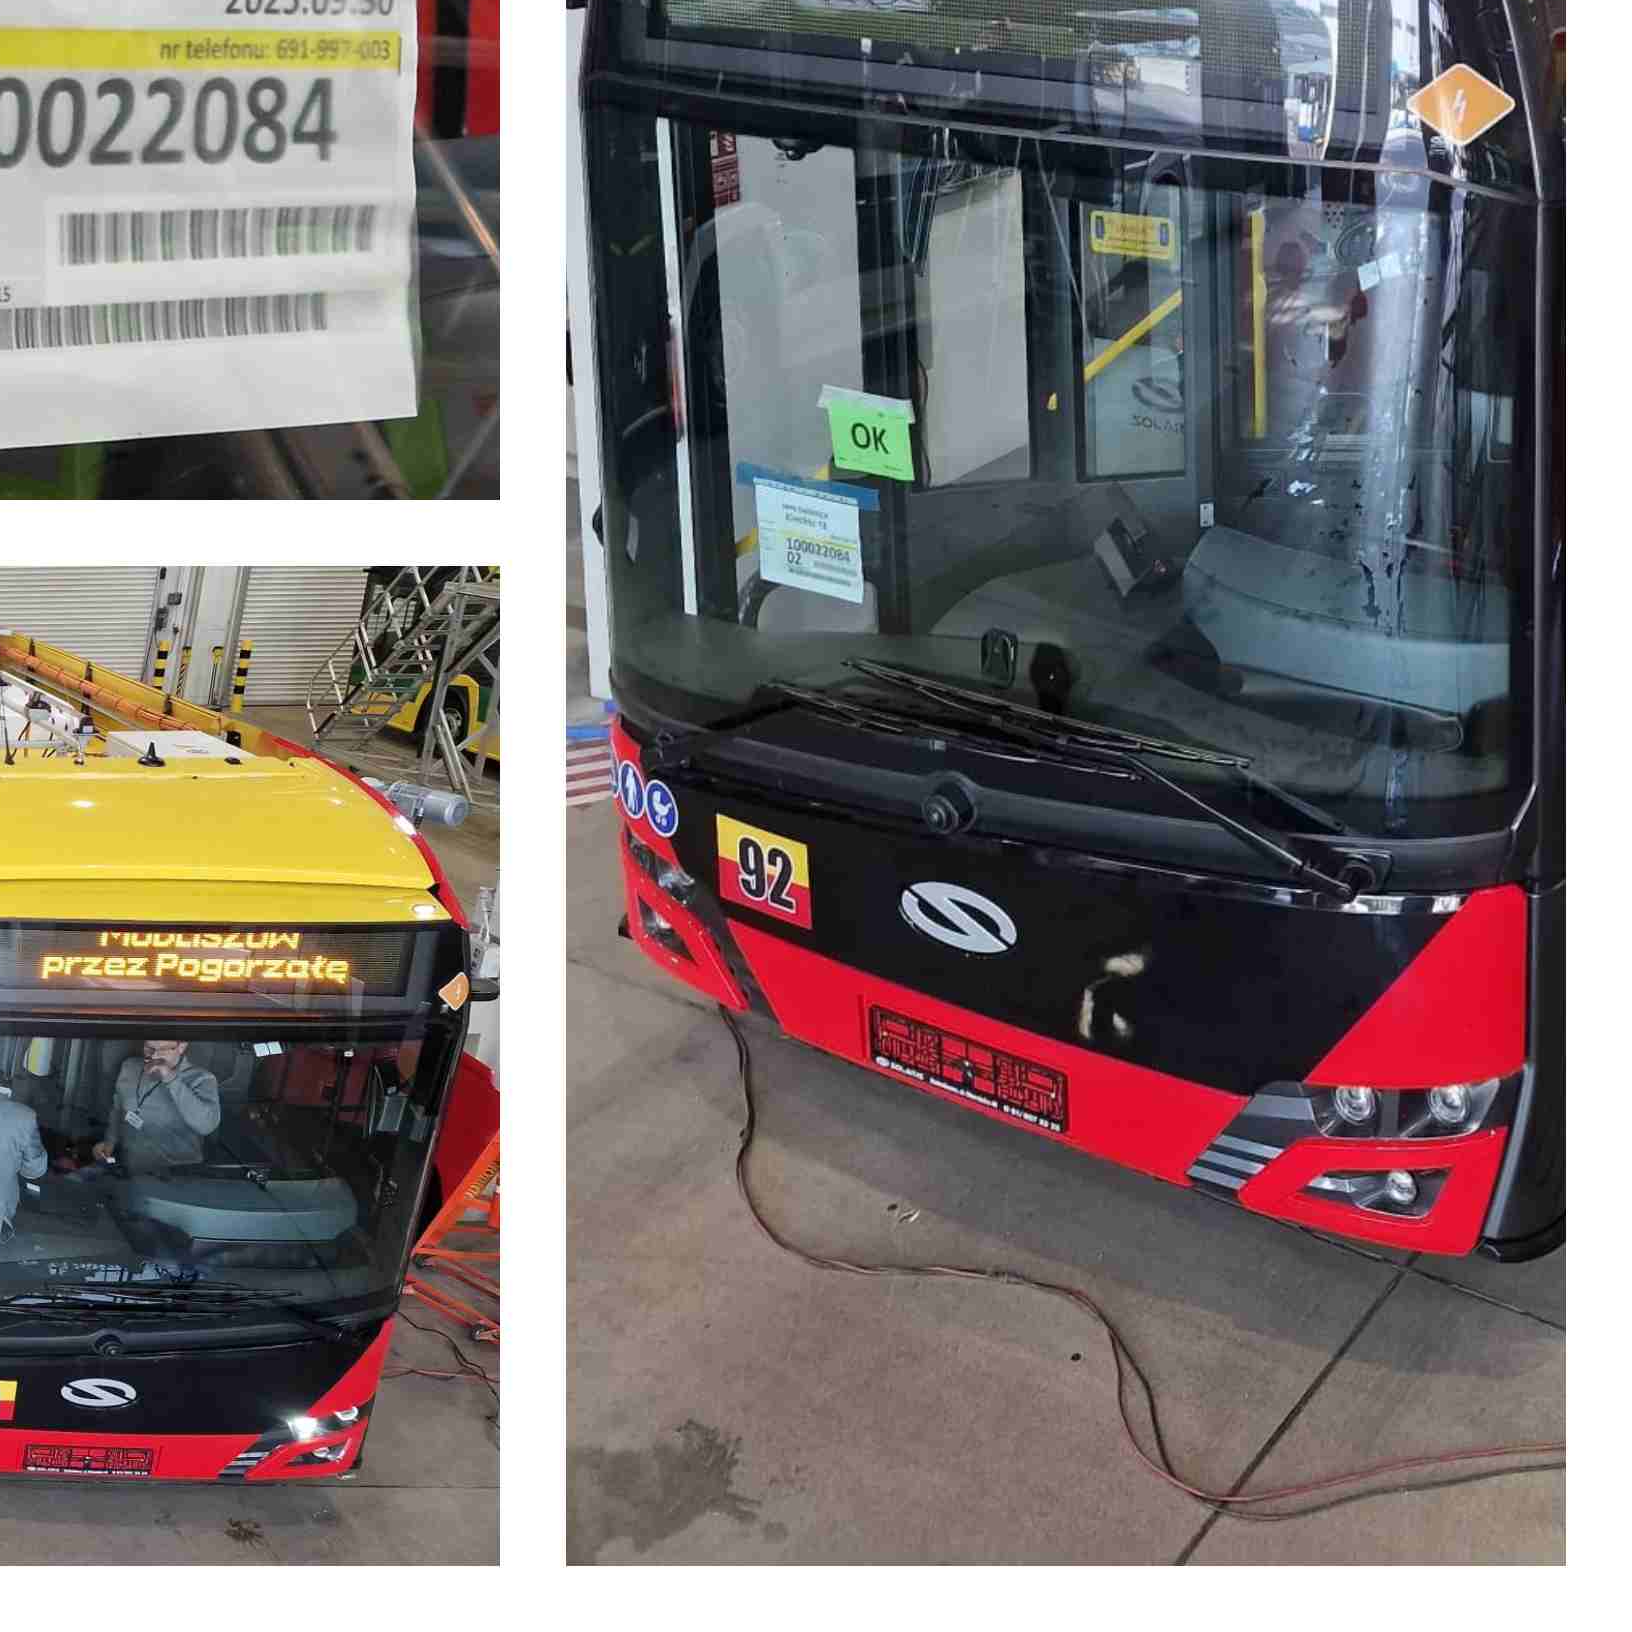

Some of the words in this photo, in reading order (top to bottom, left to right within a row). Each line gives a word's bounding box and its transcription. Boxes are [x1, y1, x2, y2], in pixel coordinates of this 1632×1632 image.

[160, 42, 179, 60] nr
[851, 422, 889, 455] OK
[737, 834, 797, 914] 92
[40, 953, 147, 980] przez
[154, 951, 350, 985] Pogorzałę
